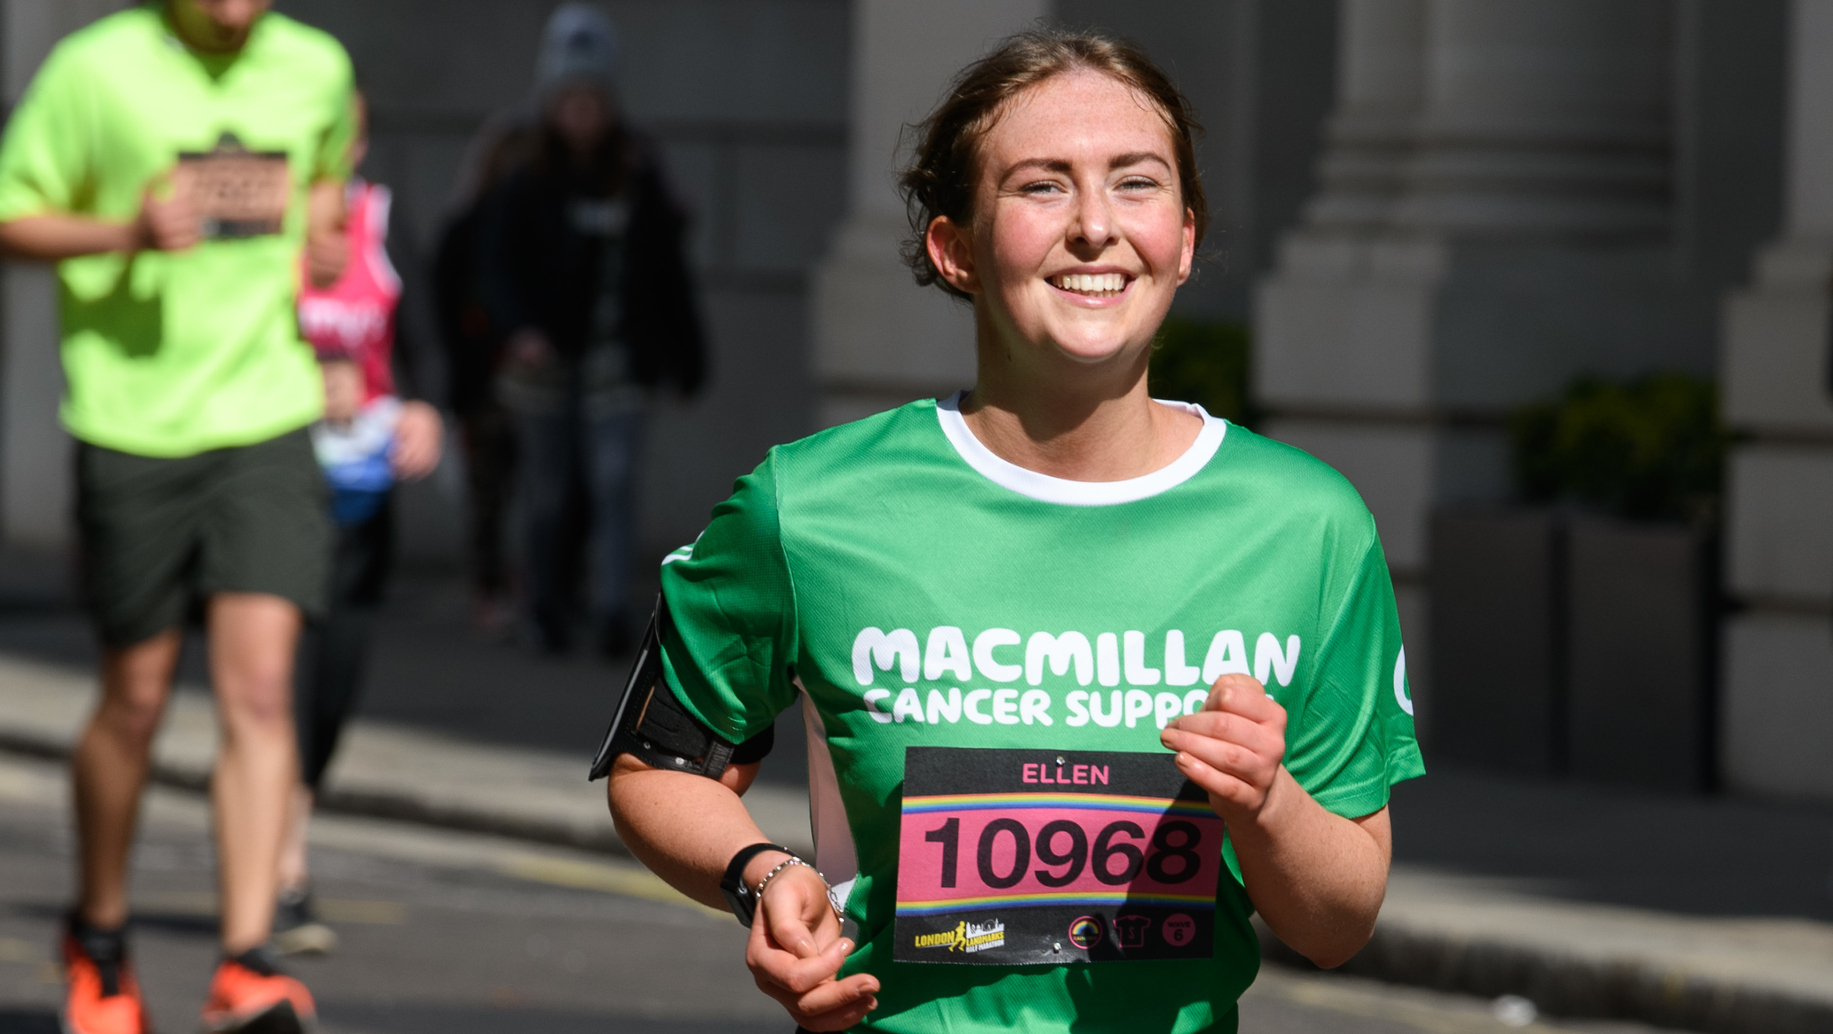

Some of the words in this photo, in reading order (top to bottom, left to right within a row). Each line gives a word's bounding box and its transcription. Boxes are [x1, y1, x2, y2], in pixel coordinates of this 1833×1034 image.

[851, 626, 1300, 687] MACMILLAN
[862, 688, 1054, 726] CANCER
[1065, 689, 1274, 729] SUPPO
[1022, 763, 1109, 785] ELLEN
[924, 817, 1201, 889] 10968
[915, 930, 955, 948] LONDON
[966, 931, 1004, 947] LANDMARKS
[1174, 929, 1183, 941] 6
